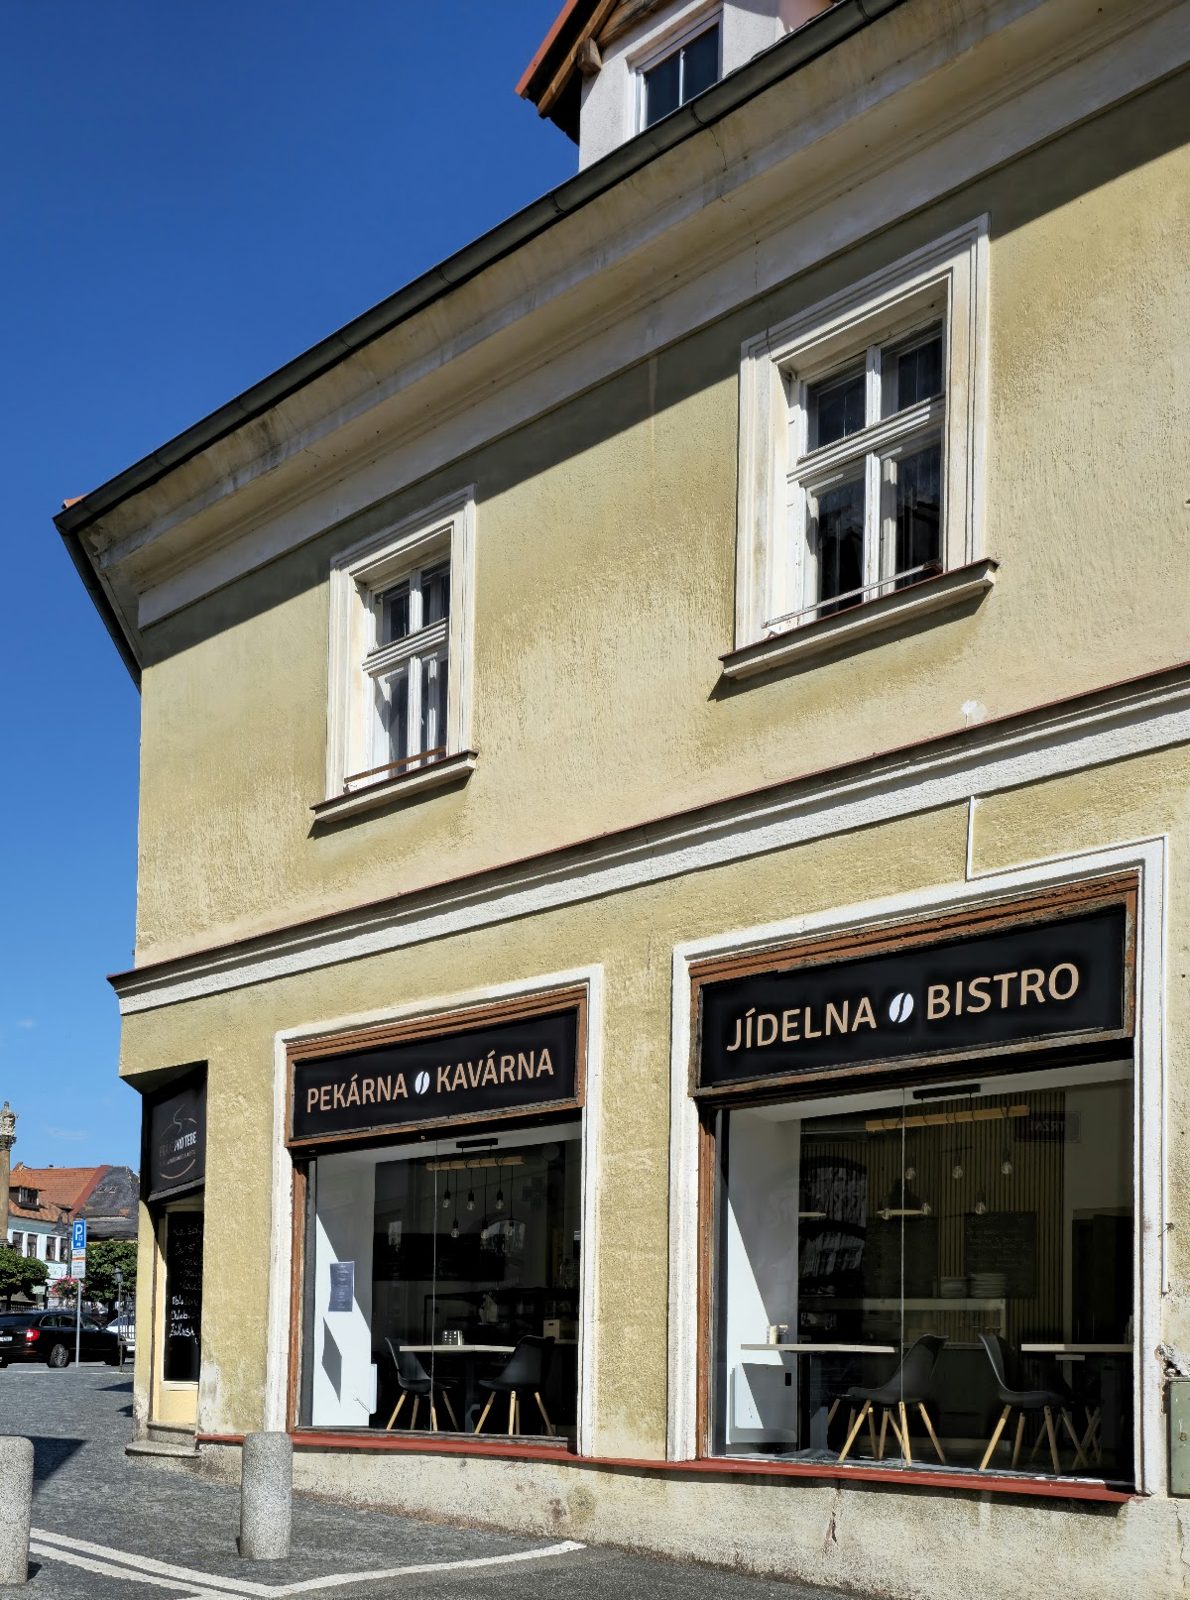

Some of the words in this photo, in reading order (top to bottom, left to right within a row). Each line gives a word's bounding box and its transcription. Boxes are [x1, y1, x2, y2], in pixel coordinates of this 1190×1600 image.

[726, 996, 877, 1052] JÍDELNA
[927, 963, 1080, 1020] BISTRO
[306, 1072, 409, 1113] PEKÁRNA
[436, 1048, 554, 1094] KAVÁRNA
[75, 1224, 83, 1241] P
